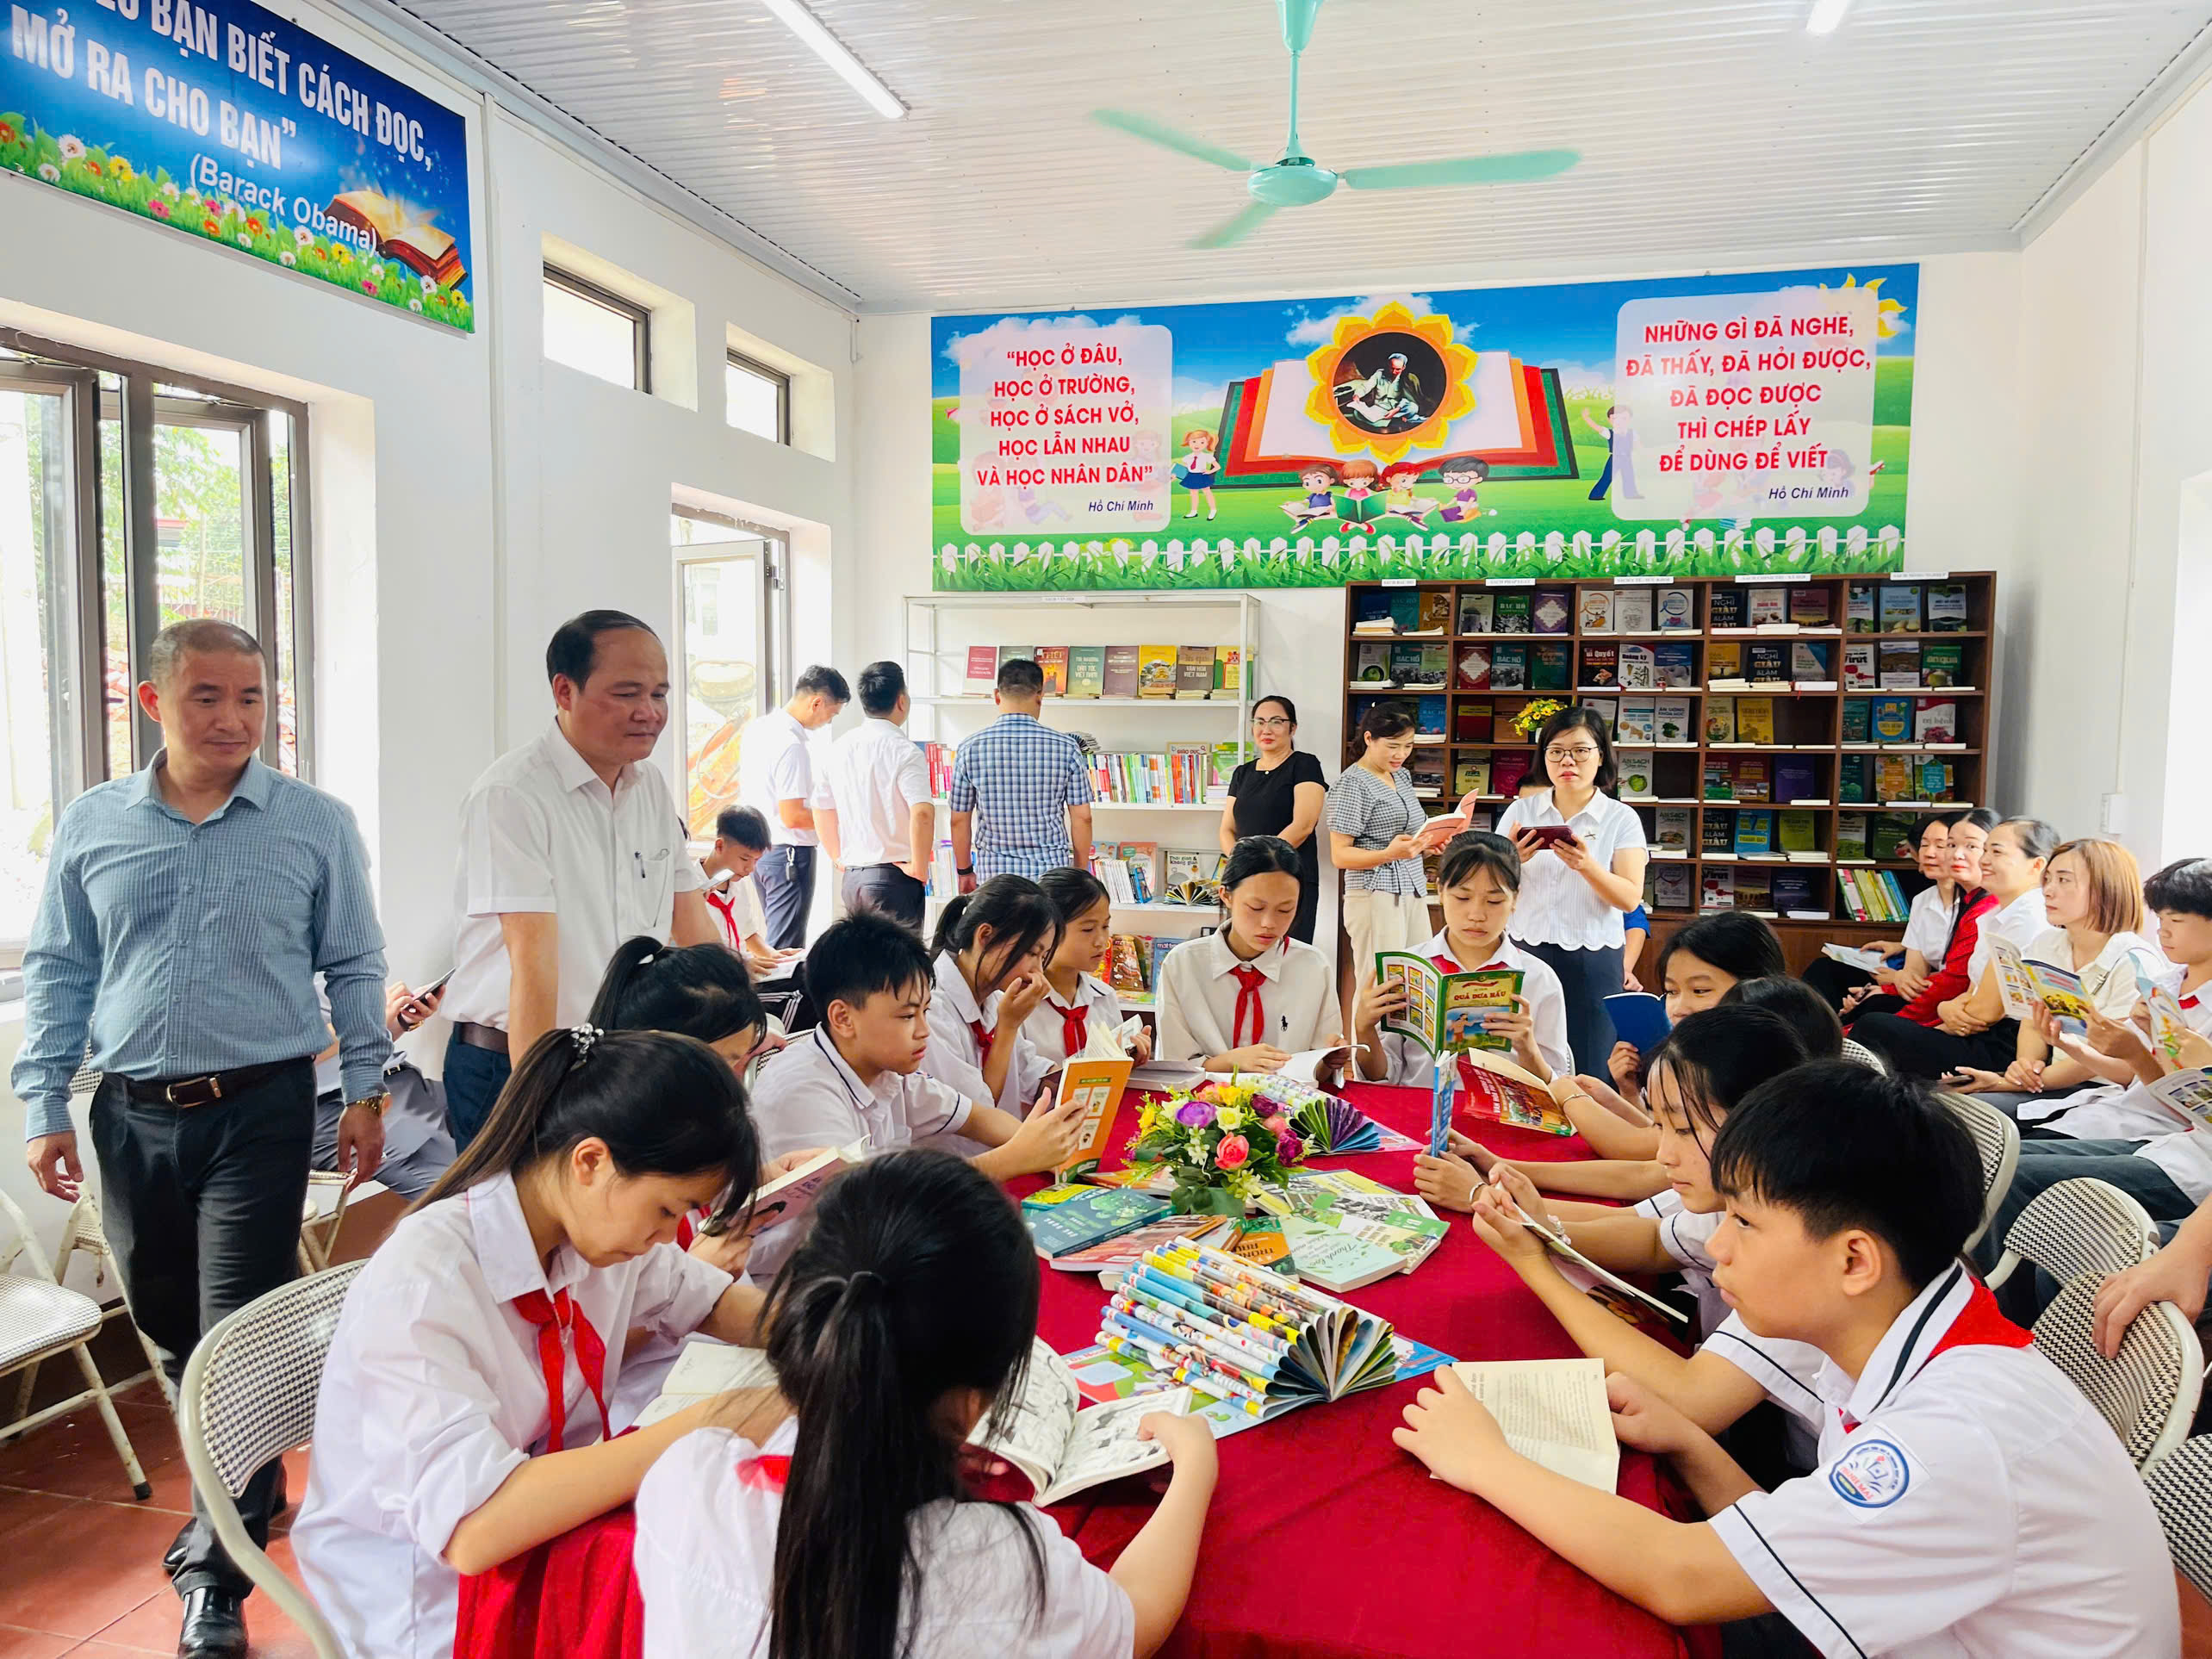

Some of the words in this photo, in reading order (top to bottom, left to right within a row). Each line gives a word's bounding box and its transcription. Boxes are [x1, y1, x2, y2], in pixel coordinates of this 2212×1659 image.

[11, 5, 77, 79] MỞ
[87, 38, 134, 107] RA
[145, 66, 210, 137] CHO
[227, 22, 290, 96] BIẾT
[299, 63, 370, 137] CÁCH
[376, 101, 432, 172] ĐỌC,
[190, 152, 286, 216] (Barack
[293, 197, 378, 258] Obama)
[1645, 320, 1718, 343] NHỮNG
[1724, 317, 1748, 339] GÌ
[1755, 315, 1783, 339] ĐÃ
[1792, 315, 1854, 337] NGHE,
[1061, 343, 1075, 364] Ở
[1081, 343, 1122, 365] ĐÂU,
[1626, 355, 1654, 376] ĐÃ
[1661, 349, 1714, 376] THẤY,
[1723, 351, 1750, 373] ĐÃ
[1758, 346, 1795, 371] HỎI
[1803, 348, 1871, 373] ĐƯỢC,
[995, 380, 1033, 401] HỌC
[1039, 374, 1053, 395] Ở
[1059, 373, 1134, 395] TRƯỜNG,
[1670, 385, 1699, 407] ĐÃ
[1706, 387, 1752, 410] ĐỌC
[1760, 383, 1822, 408] ĐƯỢC
[991, 410, 1029, 431] HỌC
[1035, 404, 1049, 426] Ở
[1054, 405, 1102, 425] SÁCH
[1678, 417, 1706, 439] THÌ
[1714, 415, 1767, 438] CHÉP
[1774, 410, 1811, 436] LẤY
[999, 440, 1038, 460] HỌC
[1044, 431, 1076, 455] LẪN
[1082, 436, 1131, 453] NHAU
[1660, 444, 1685, 472] ĐỂ
[1690, 450, 1748, 471] DÙNG
[1755, 442, 1781, 469] ĐỂ
[1787, 443, 1828, 469] VIẾT
[978, 465, 1001, 487] VÀ
[1007, 469, 1045, 489] HỌC
[1052, 463, 1100, 484] NHÂN
[1089, 500, 1103, 513] Hồ
[1106, 500, 1124, 512] Chí
[1128, 500, 1153, 511] Minh
[1768, 485, 1786, 500] Hồ
[1791, 487, 1814, 499] Chí
[1817, 487, 1849, 498] Minh
